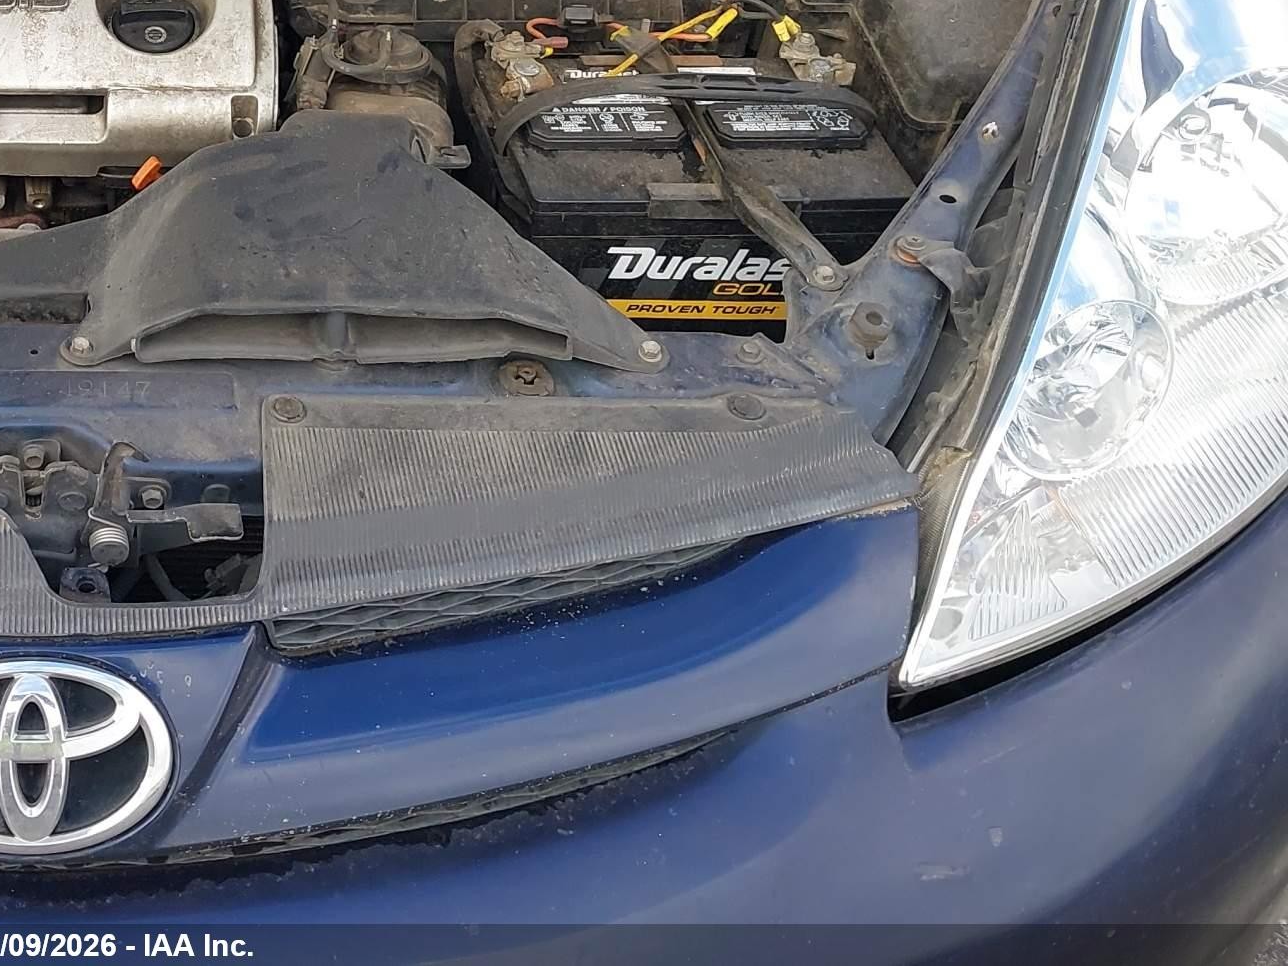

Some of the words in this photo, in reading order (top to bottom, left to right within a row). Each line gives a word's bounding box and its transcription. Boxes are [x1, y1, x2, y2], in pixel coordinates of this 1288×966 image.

[607, 246, 793, 281] Duralas
[713, 283, 784, 296] GOL
[626, 304, 705, 314] PROVEN
[712, 305, 777, 315] TOUGH
